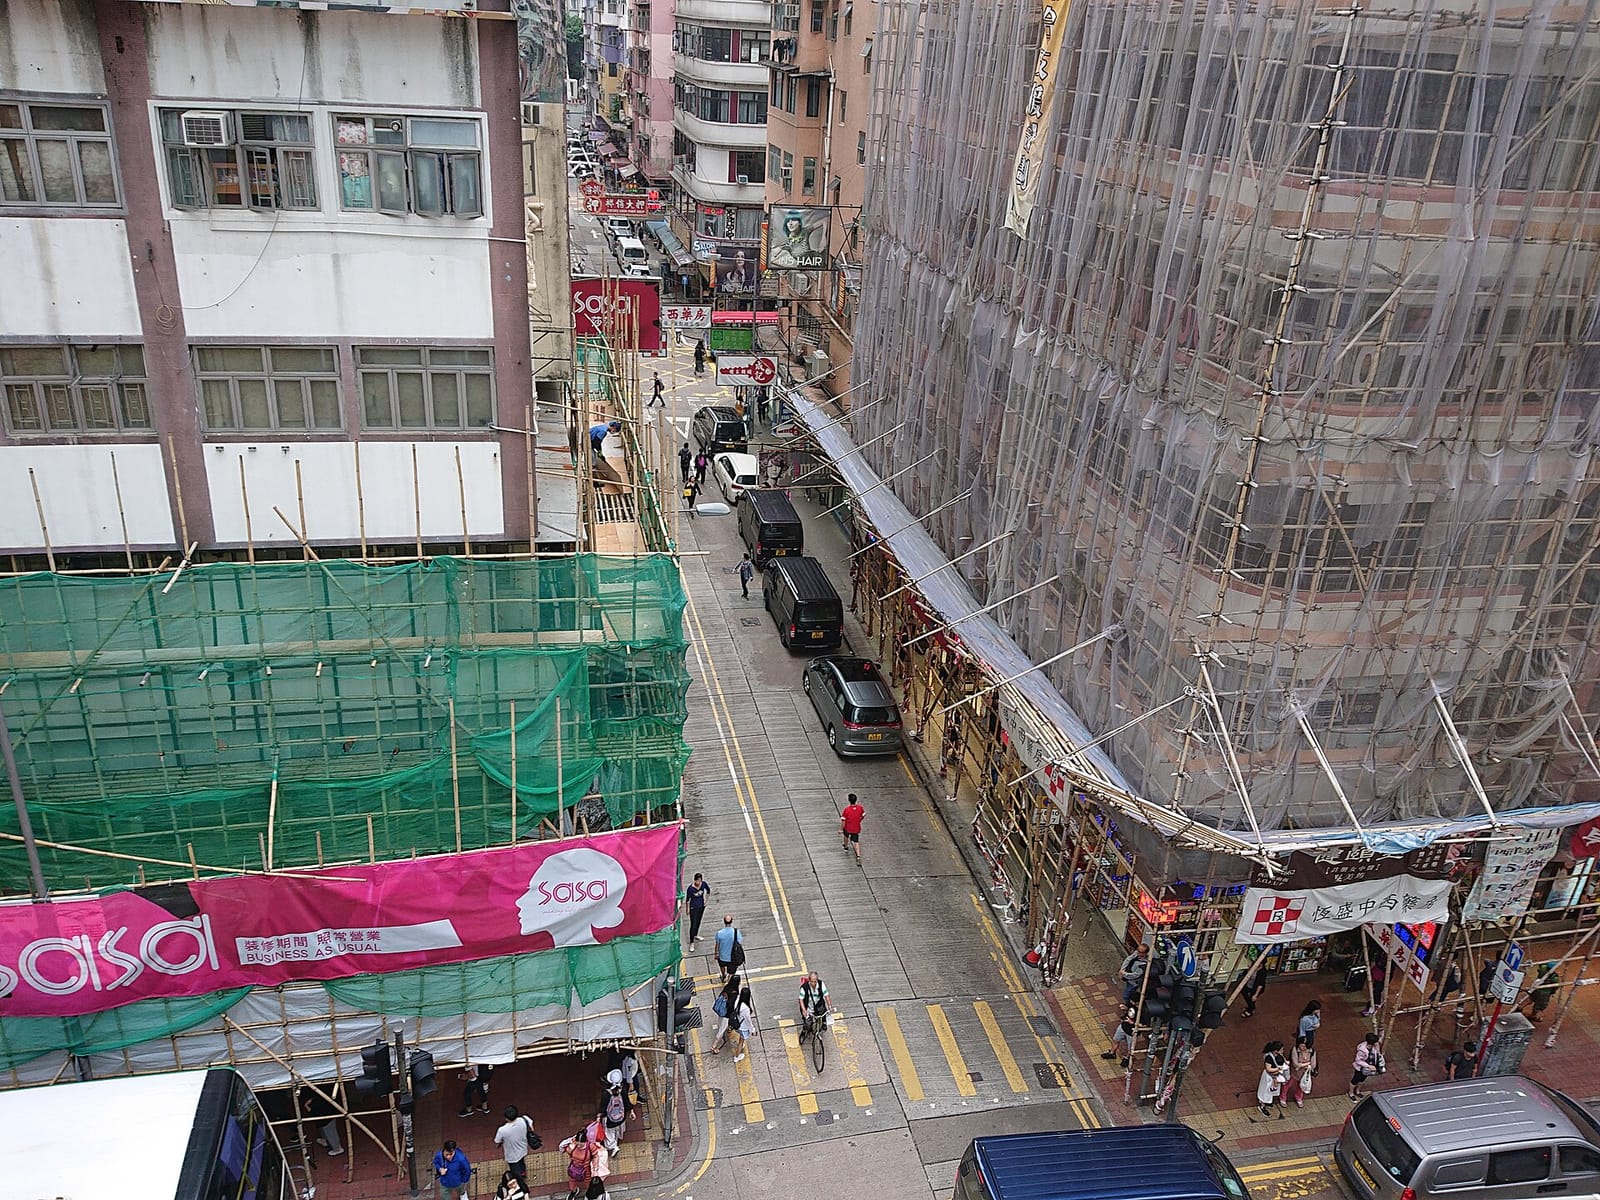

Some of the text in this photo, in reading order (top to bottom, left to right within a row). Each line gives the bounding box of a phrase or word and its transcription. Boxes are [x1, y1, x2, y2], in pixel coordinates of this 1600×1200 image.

[796, 257, 823, 266] HAIR
[660, 307, 707, 321] 西藥房
[244, 930, 382, 952] 裝修期間 照常營業
[247, 943, 381, 963] BUSINESS AS USUAL
